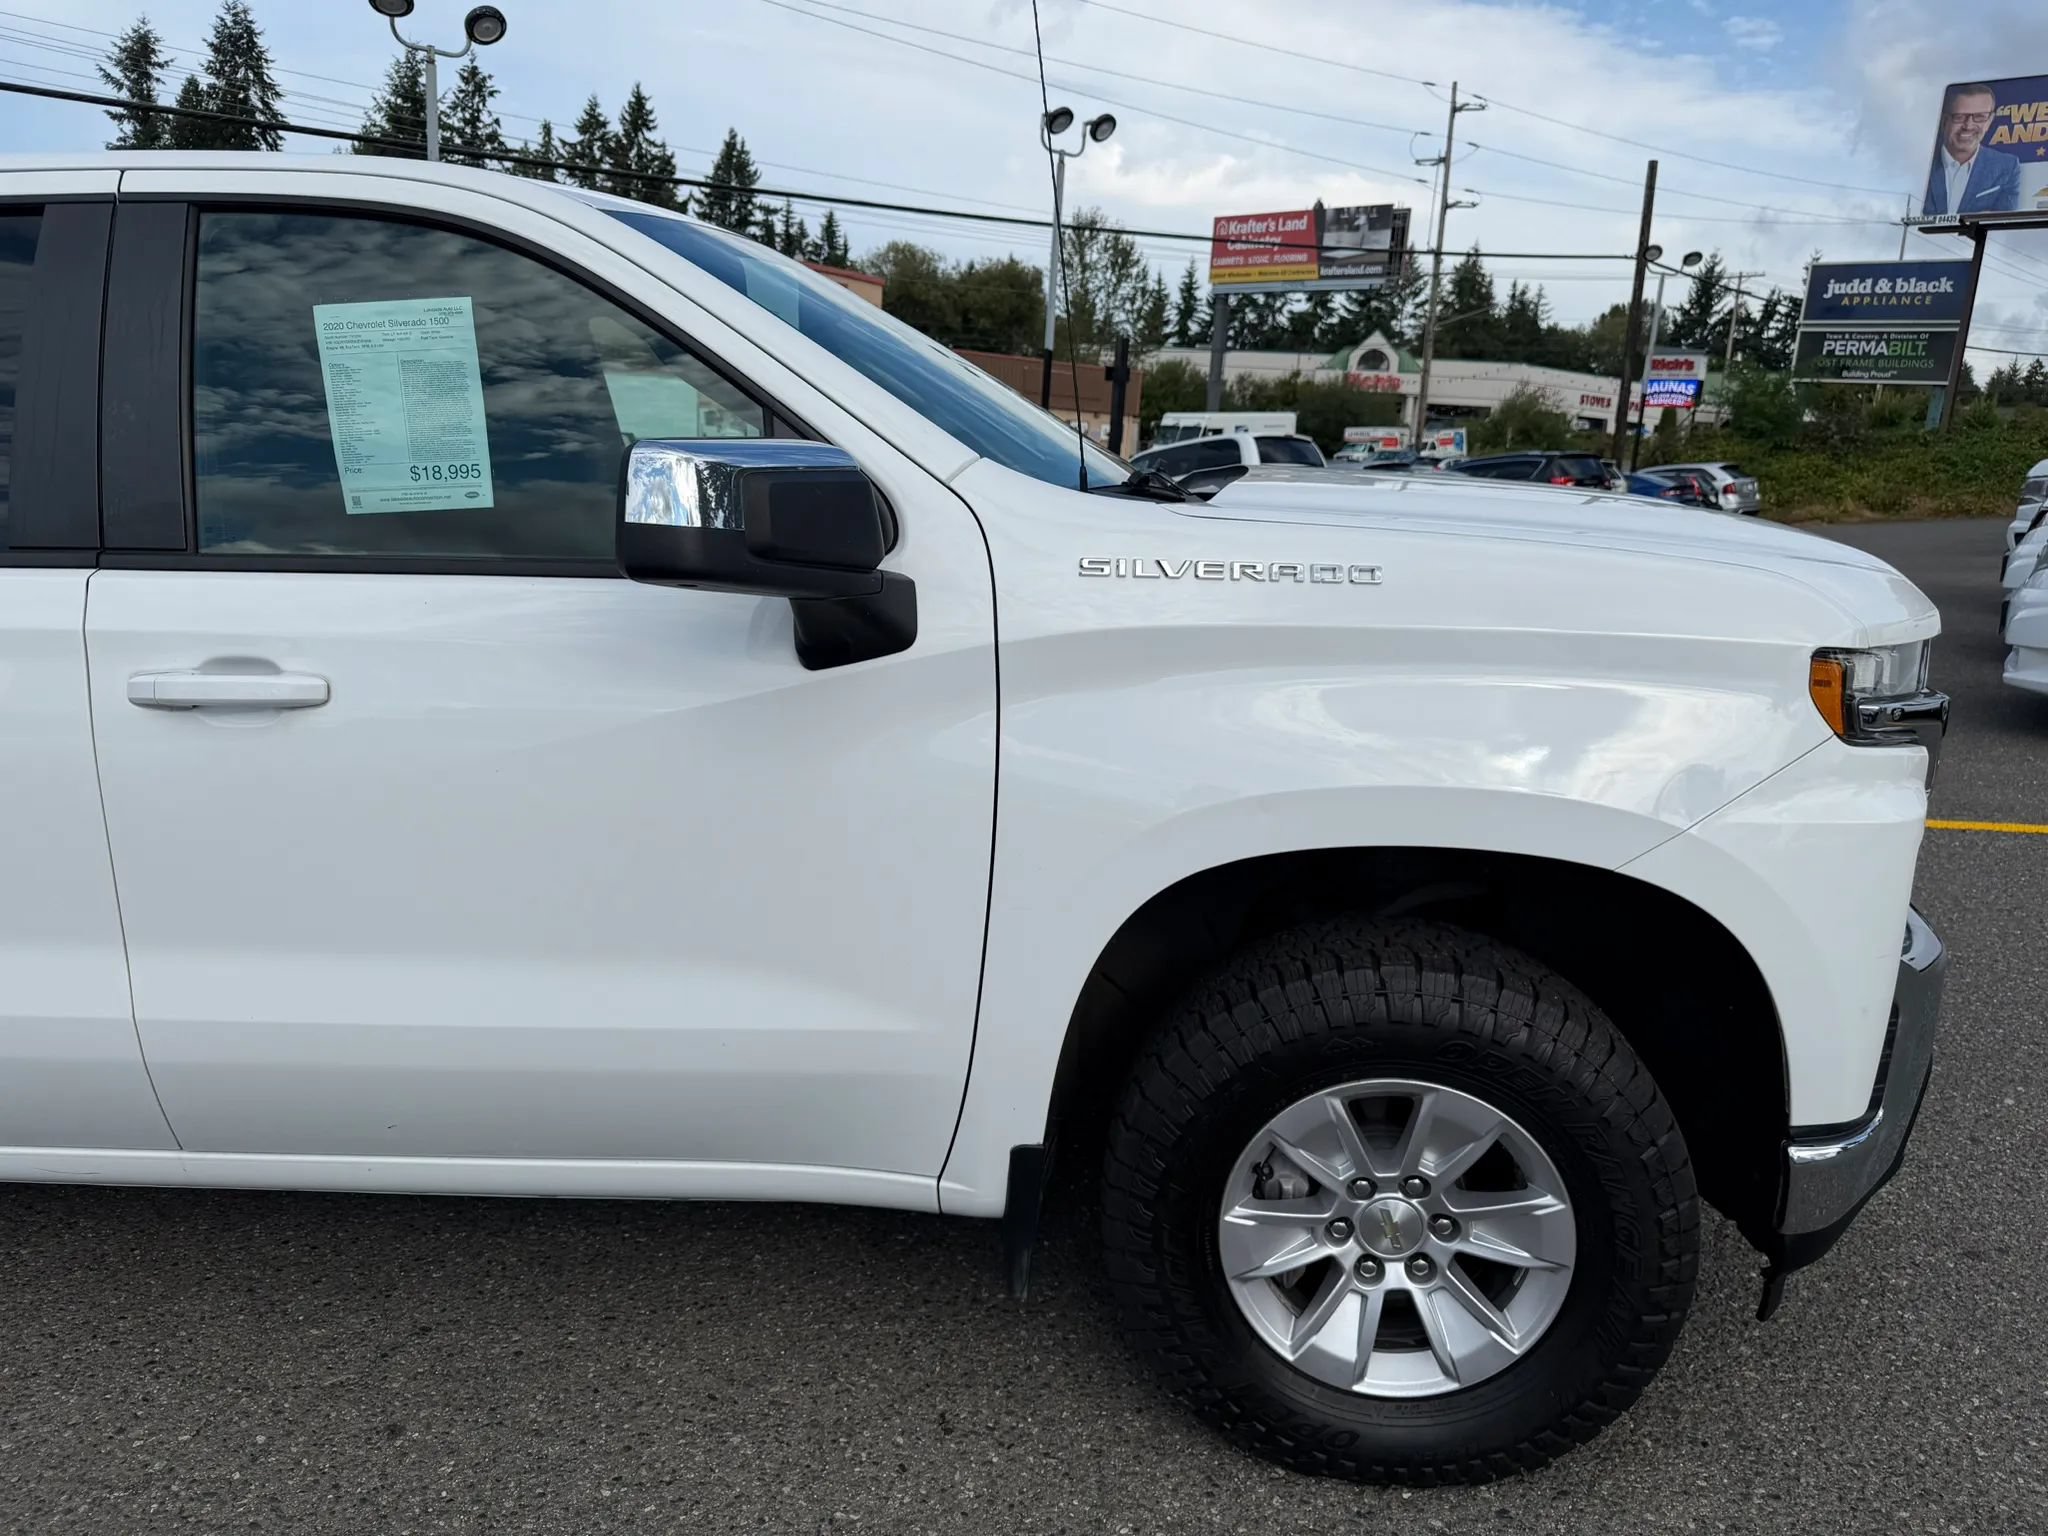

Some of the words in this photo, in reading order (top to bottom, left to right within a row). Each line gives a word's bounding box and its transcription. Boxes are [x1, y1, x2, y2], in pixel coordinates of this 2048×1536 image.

[1988, 122, 2048, 145] AND
[1228, 217, 1276, 235] Krafter's
[1278, 215, 1308, 232] Land
[1213, 257, 1244, 266] CABINETS
[1273, 253, 1309, 263] FLOORING
[1320, 264, 1384, 276] kraftersland.com
[1822, 278, 1873, 299] judd
[1874, 278, 1893, 294] &
[1895, 276, 1954, 293] black
[1841, 295, 1933, 306] APPLIANCE
[322, 322, 344, 331] 2020
[346, 319, 386, 330] Chevrolet
[388, 317, 426, 328] Silverado
[429, 316, 450, 326] 1500
[1651, 358, 1695, 371] Rich's
[1840, 359, 1875, 368] FRAME
[1877, 359, 1935, 369] BUILDINGS
[1841, 370, 1869, 378] Building
[1579, 394, 1612, 409] STOVES
[410, 463, 481, 483] $18,995
[1079, 557, 1383, 584] SILVERADO
